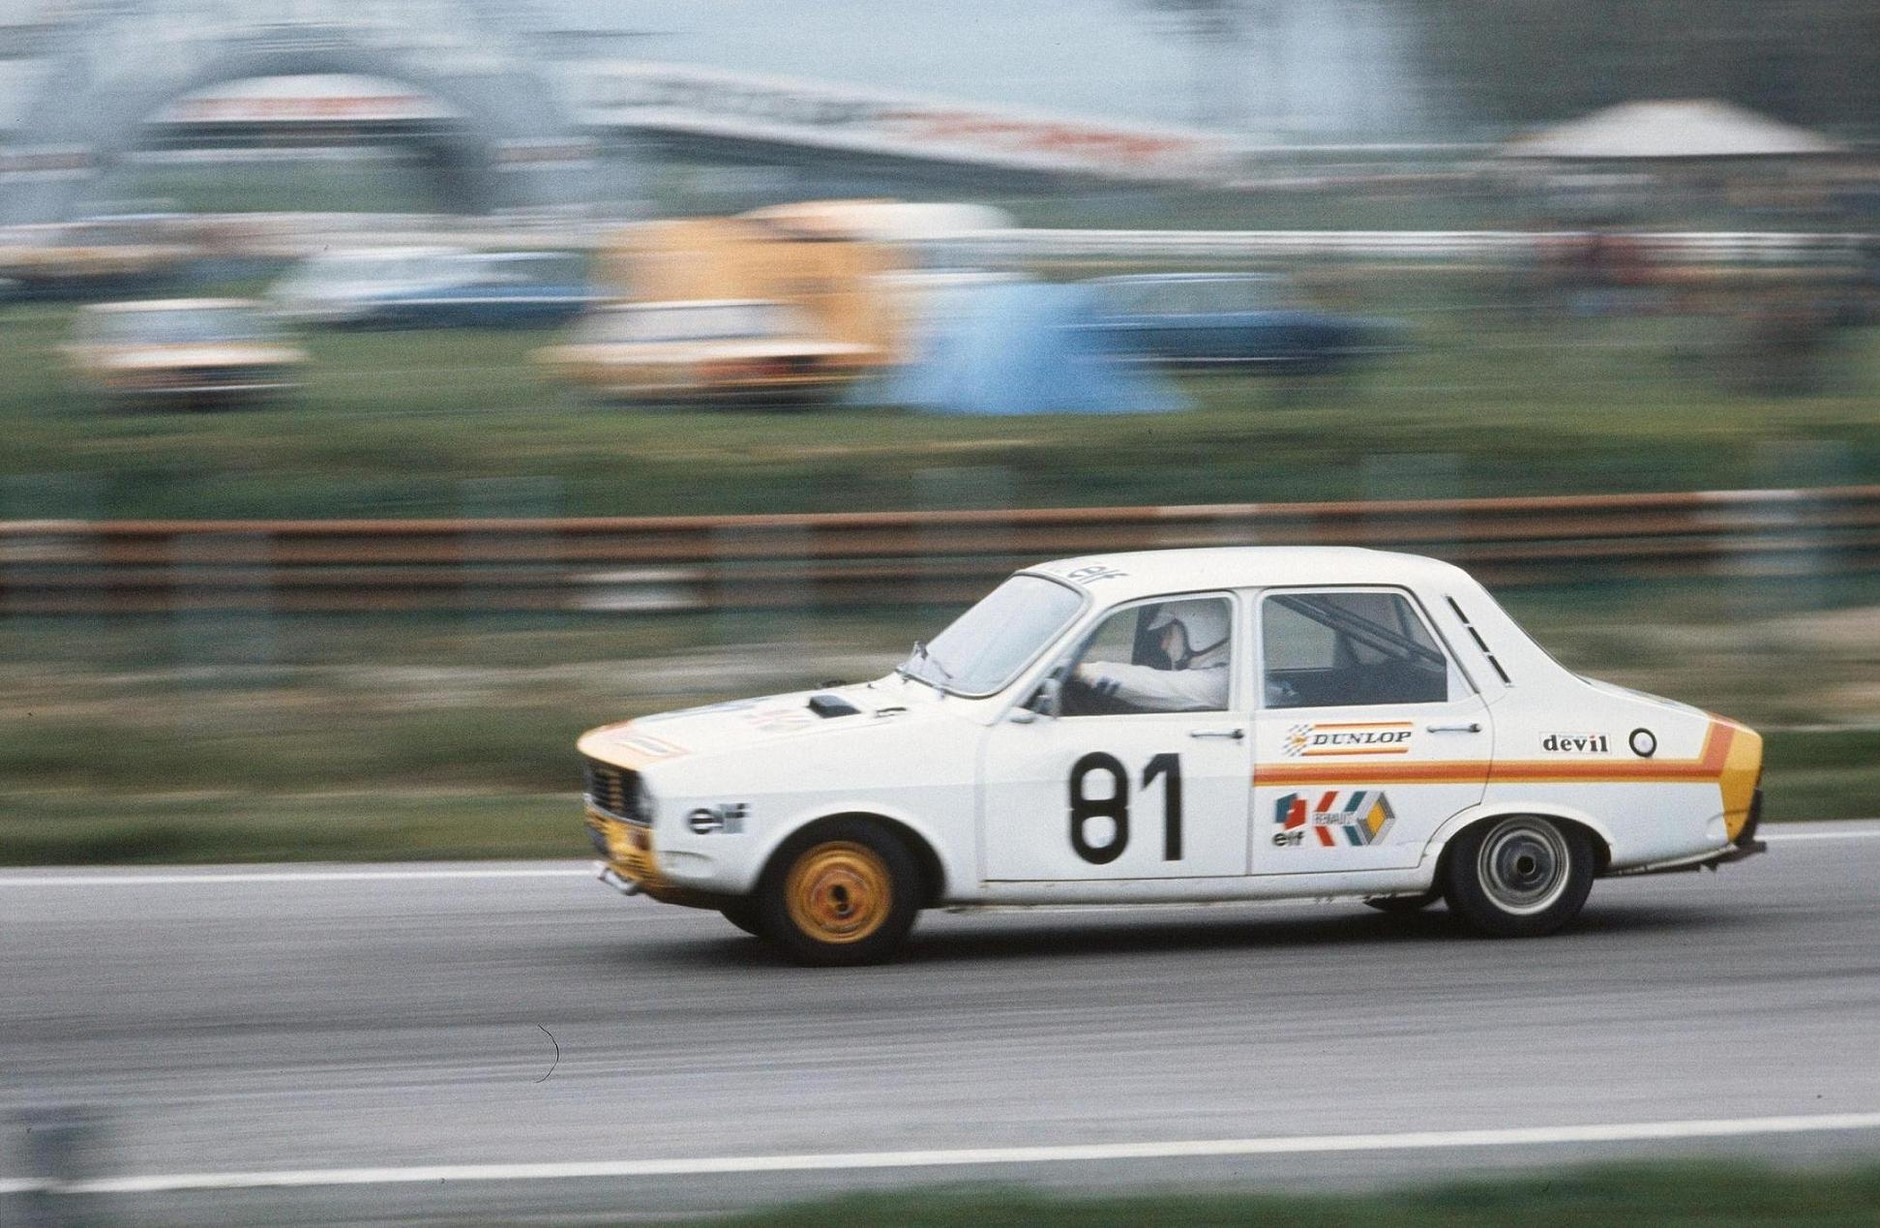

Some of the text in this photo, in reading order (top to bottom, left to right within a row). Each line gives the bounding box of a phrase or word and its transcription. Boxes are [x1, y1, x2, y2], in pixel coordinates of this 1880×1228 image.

[1313, 731, 1412, 745] DUNLOP
[1542, 734, 1608, 752] devil
[1069, 751, 1182, 865] 81
[687, 803, 748, 834] elf
[1272, 831, 1304, 846] elf
